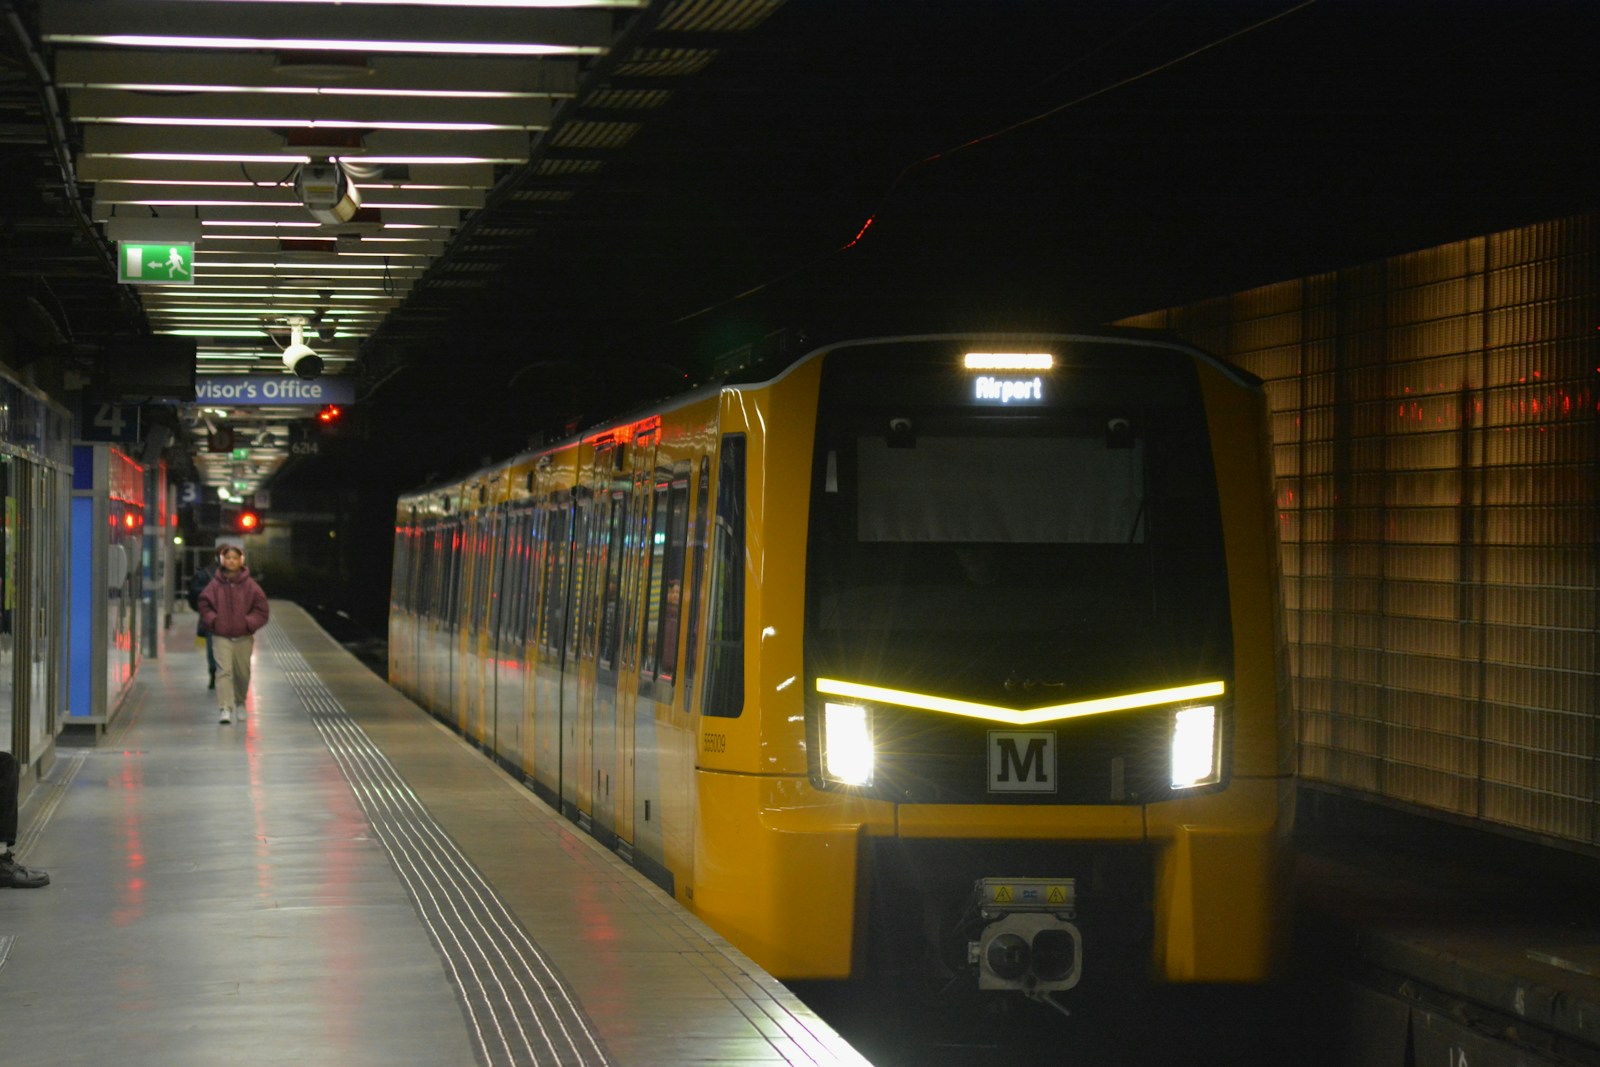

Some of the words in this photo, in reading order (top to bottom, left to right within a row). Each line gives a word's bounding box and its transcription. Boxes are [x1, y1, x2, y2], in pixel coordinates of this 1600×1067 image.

[263, 380, 322, 399] Office
[975, 377, 1042, 403] Airport
[94, 402, 127, 436] 4
[182, 481, 197, 502] 3
[997, 738, 1048, 783] M
